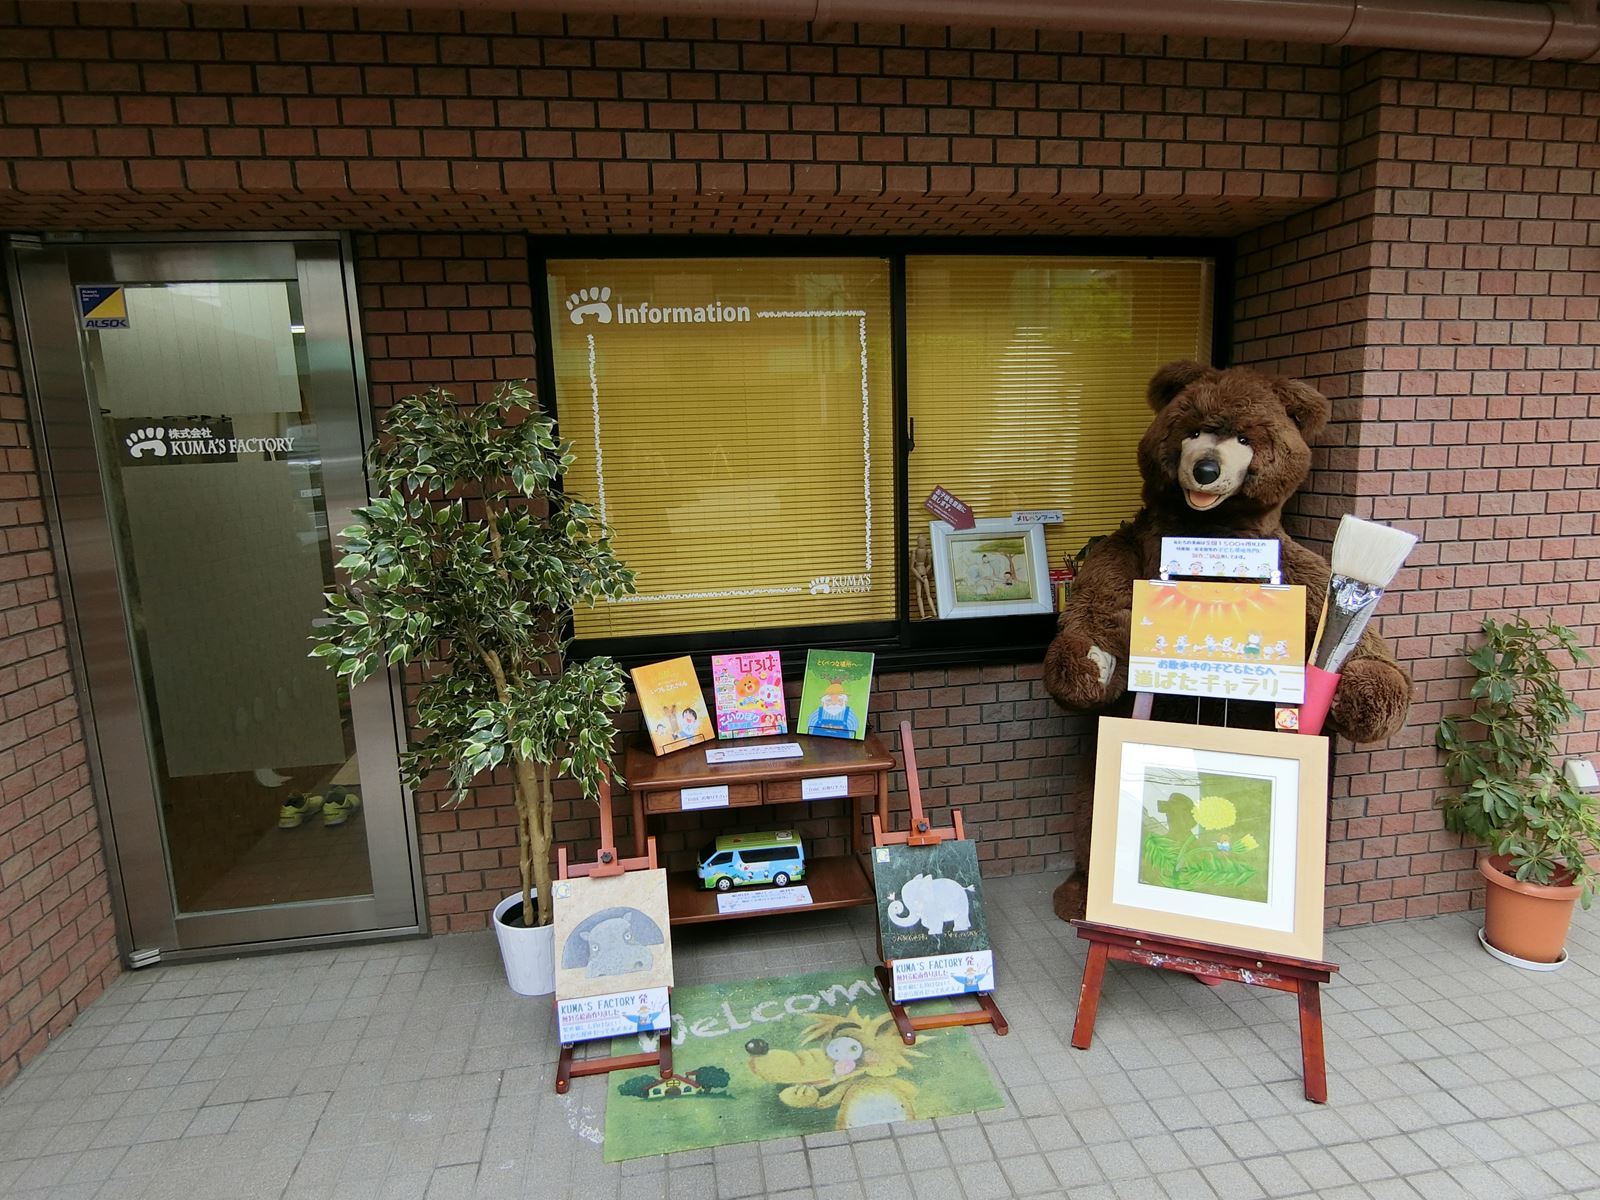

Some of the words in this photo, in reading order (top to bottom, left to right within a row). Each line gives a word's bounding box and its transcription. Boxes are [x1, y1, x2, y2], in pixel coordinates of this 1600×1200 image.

[617, 301, 751, 324] Information
[85, 319, 127, 328] ALSOK
[168, 427, 213, 439] 株式会社
[171, 438, 226, 456] KUMA'S
[229, 437, 295, 454] FACTORY
[831, 573, 871, 587] KUMA'S
[831, 586, 871, 594] FACTORY
[735, 654, 778, 673] ひろば
[1157, 660, 1277, 676] お散歩中の子どもたちへ
[1135, 669, 1301, 697] 道ばたギャラリー
[896, 962, 925, 974] KUMA'S
[929, 957, 963, 970] FACTORY
[561, 1002, 593, 1015] KUMA'S
[597, 996, 635, 1010] FACTORY
